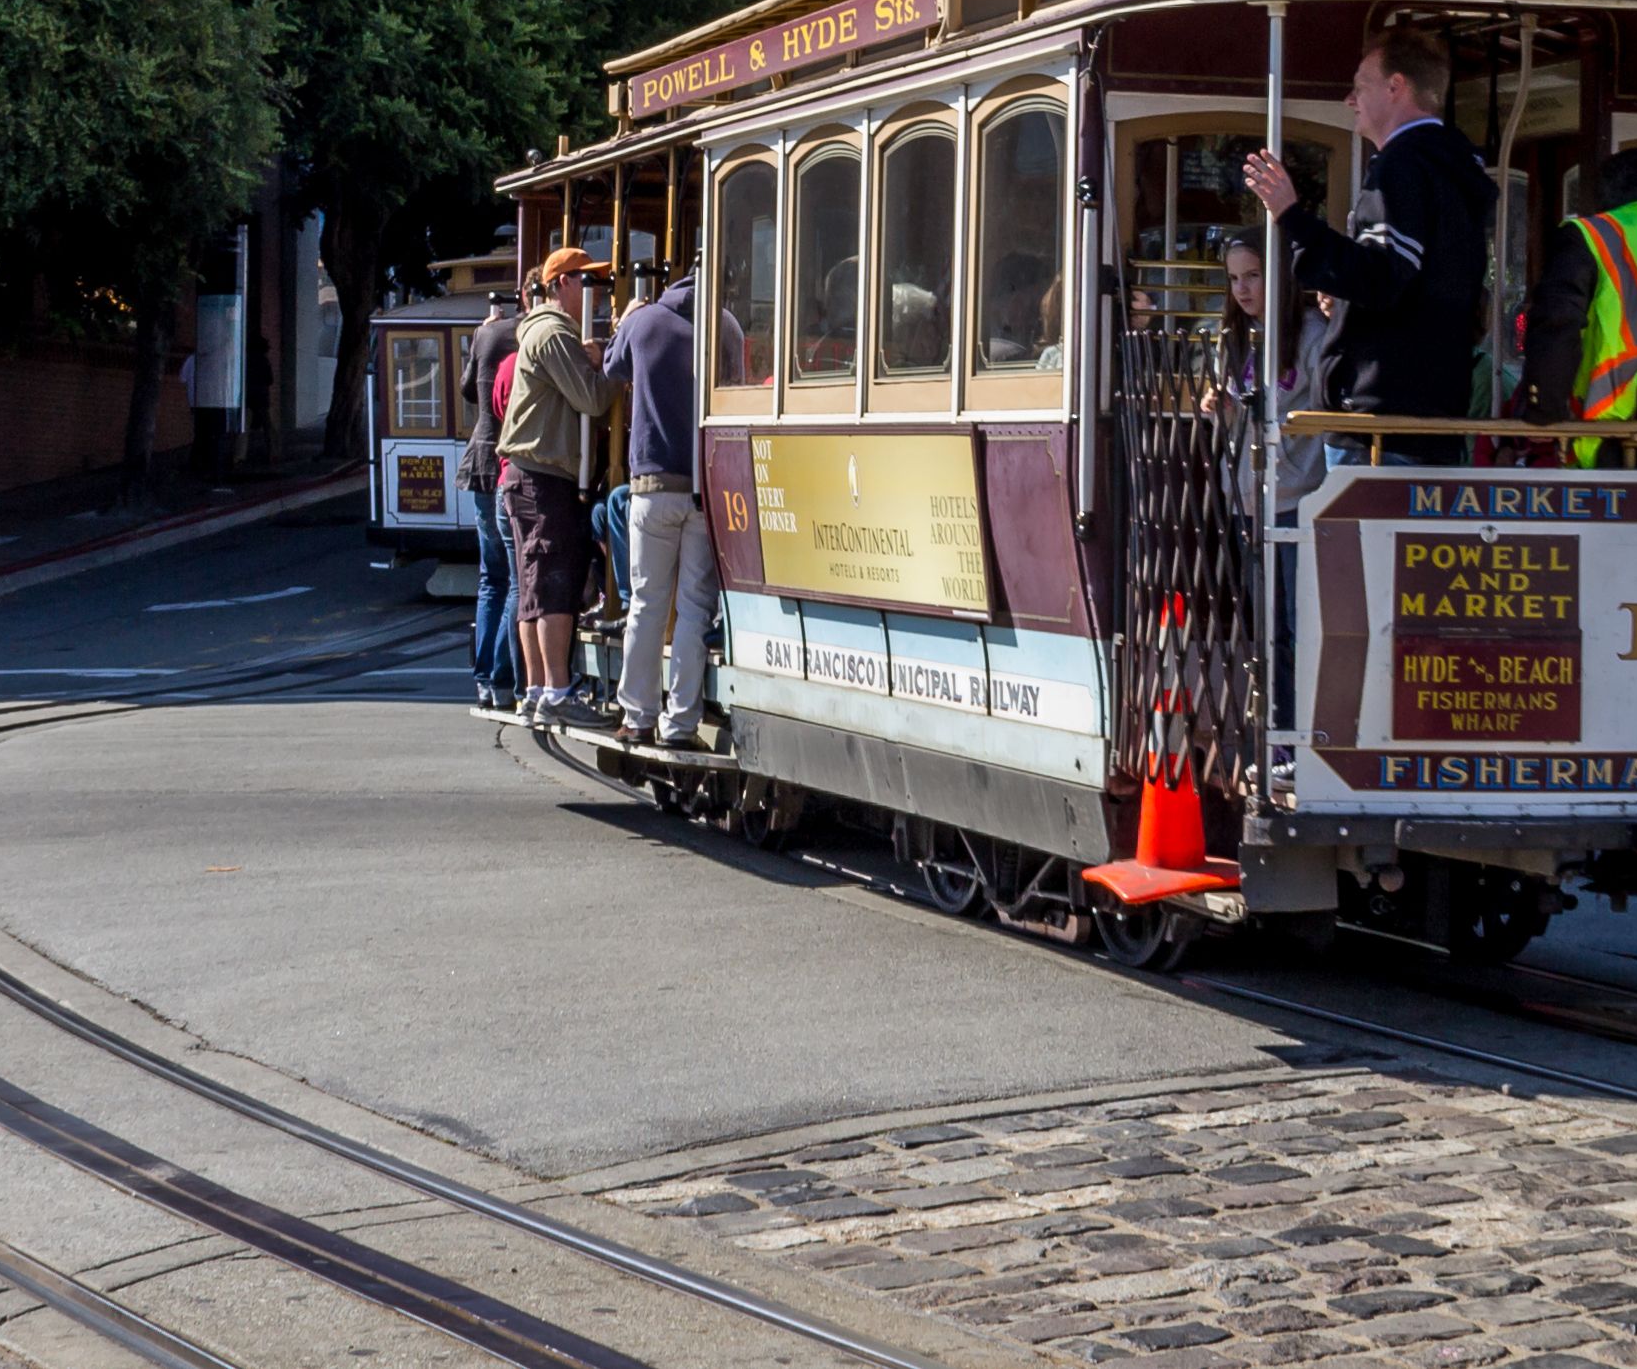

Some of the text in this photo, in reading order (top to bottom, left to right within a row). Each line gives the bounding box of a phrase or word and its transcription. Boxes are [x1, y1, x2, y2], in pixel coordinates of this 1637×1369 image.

[643, 52, 735, 109] POWELL
[749, 39, 767, 73] &
[782, 8, 858, 62] HYDE
[752, 439, 773, 460] NOT
[755, 463, 770, 483] ON
[757, 486, 785, 509] EVERY
[930, 495, 977, 520] HOTELS
[1409, 484, 1627, 519] MARKET
[723, 490, 749, 532] 19
[759, 510, 797, 533] CORNER
[930, 523, 980, 547] AROUND
[957, 551, 983, 575] THE
[1405, 543, 1570, 571] POWELL
[829, 562, 856, 579] HOTELS
[867, 566, 900, 584] RESORTS
[1449, 572, 1530, 592] AND
[942, 577, 985, 601] WORLD
[1401, 592, 1573, 619] MARKET
[766, 639, 792, 669] SAN
[1403, 655, 1461, 682] HYDE
[1499, 655, 1574, 685] BEACH
[1417, 691, 1558, 711] FISHERMANS
[1451, 713, 1523, 732] WHARF
